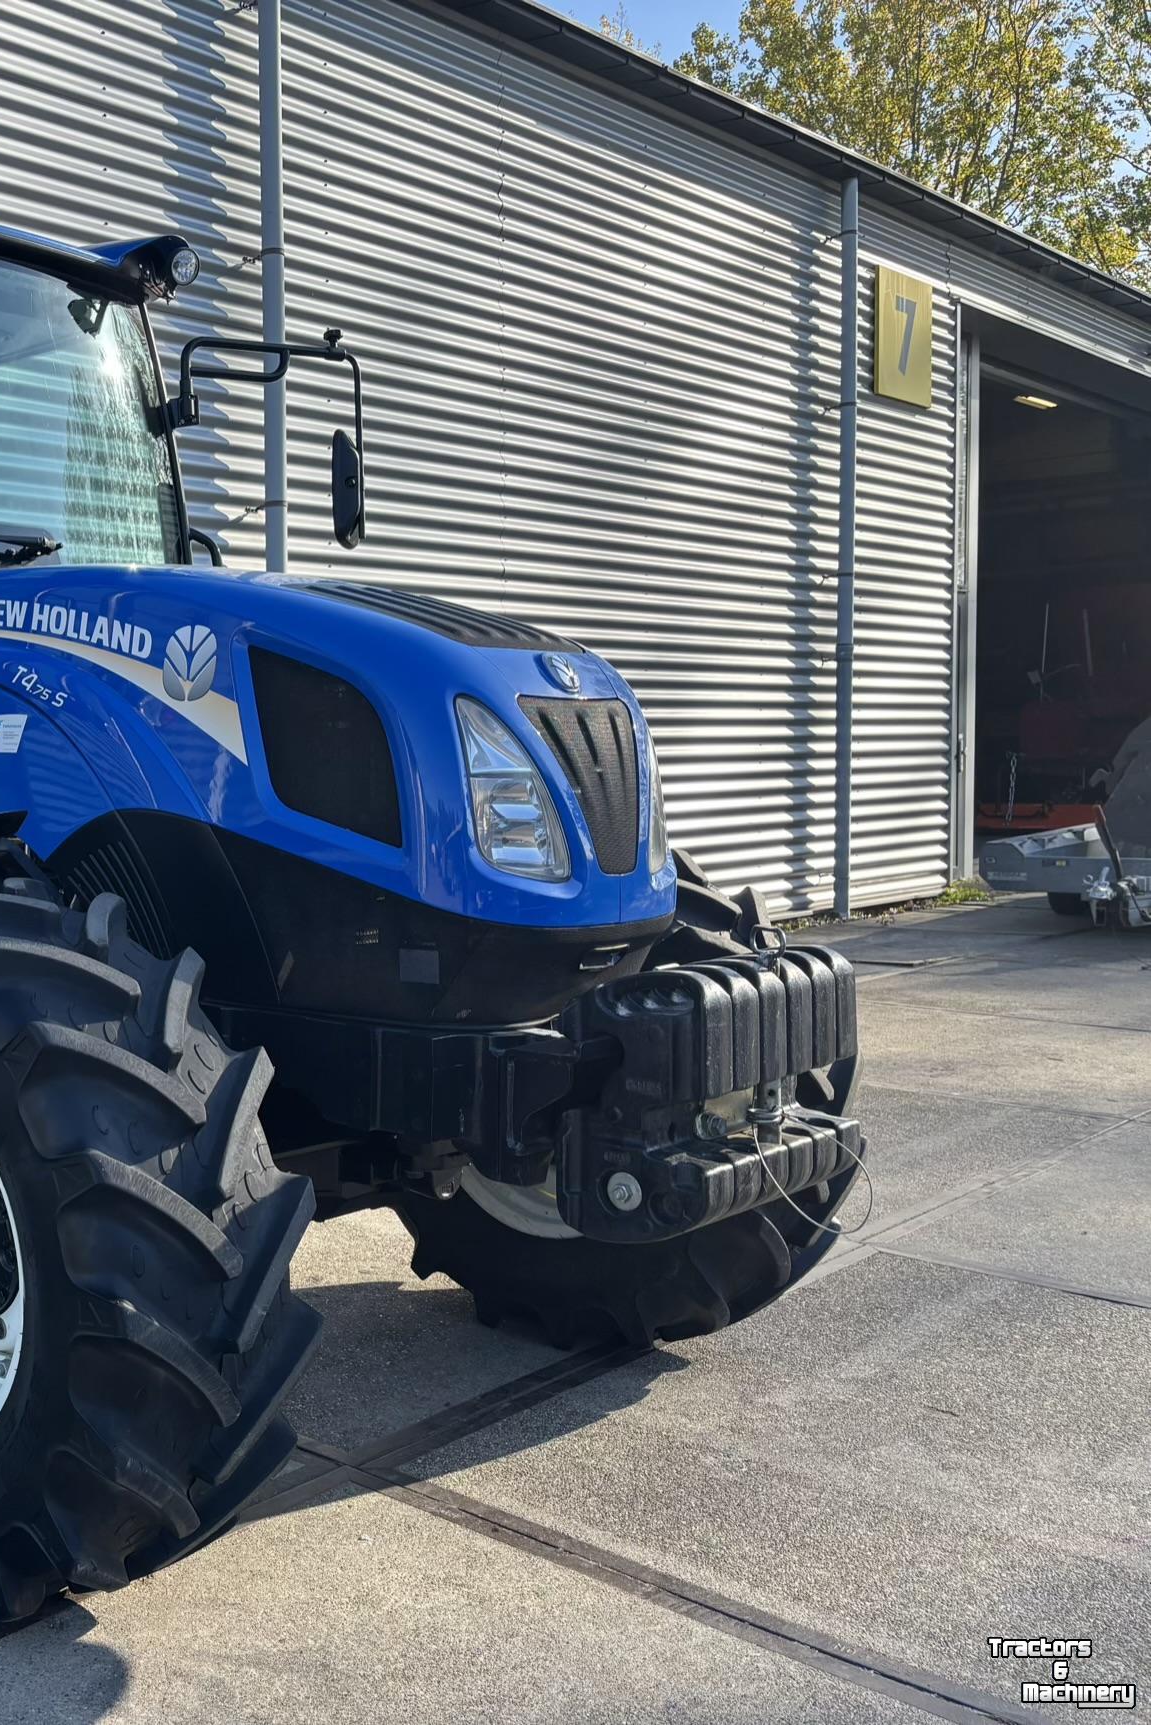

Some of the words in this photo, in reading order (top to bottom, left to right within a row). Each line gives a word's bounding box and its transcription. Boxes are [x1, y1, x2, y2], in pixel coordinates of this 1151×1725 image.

[895, 294, 917, 377] 7
[31, 602, 152, 660] HOLLAND
[51, 691, 69, 707] S
